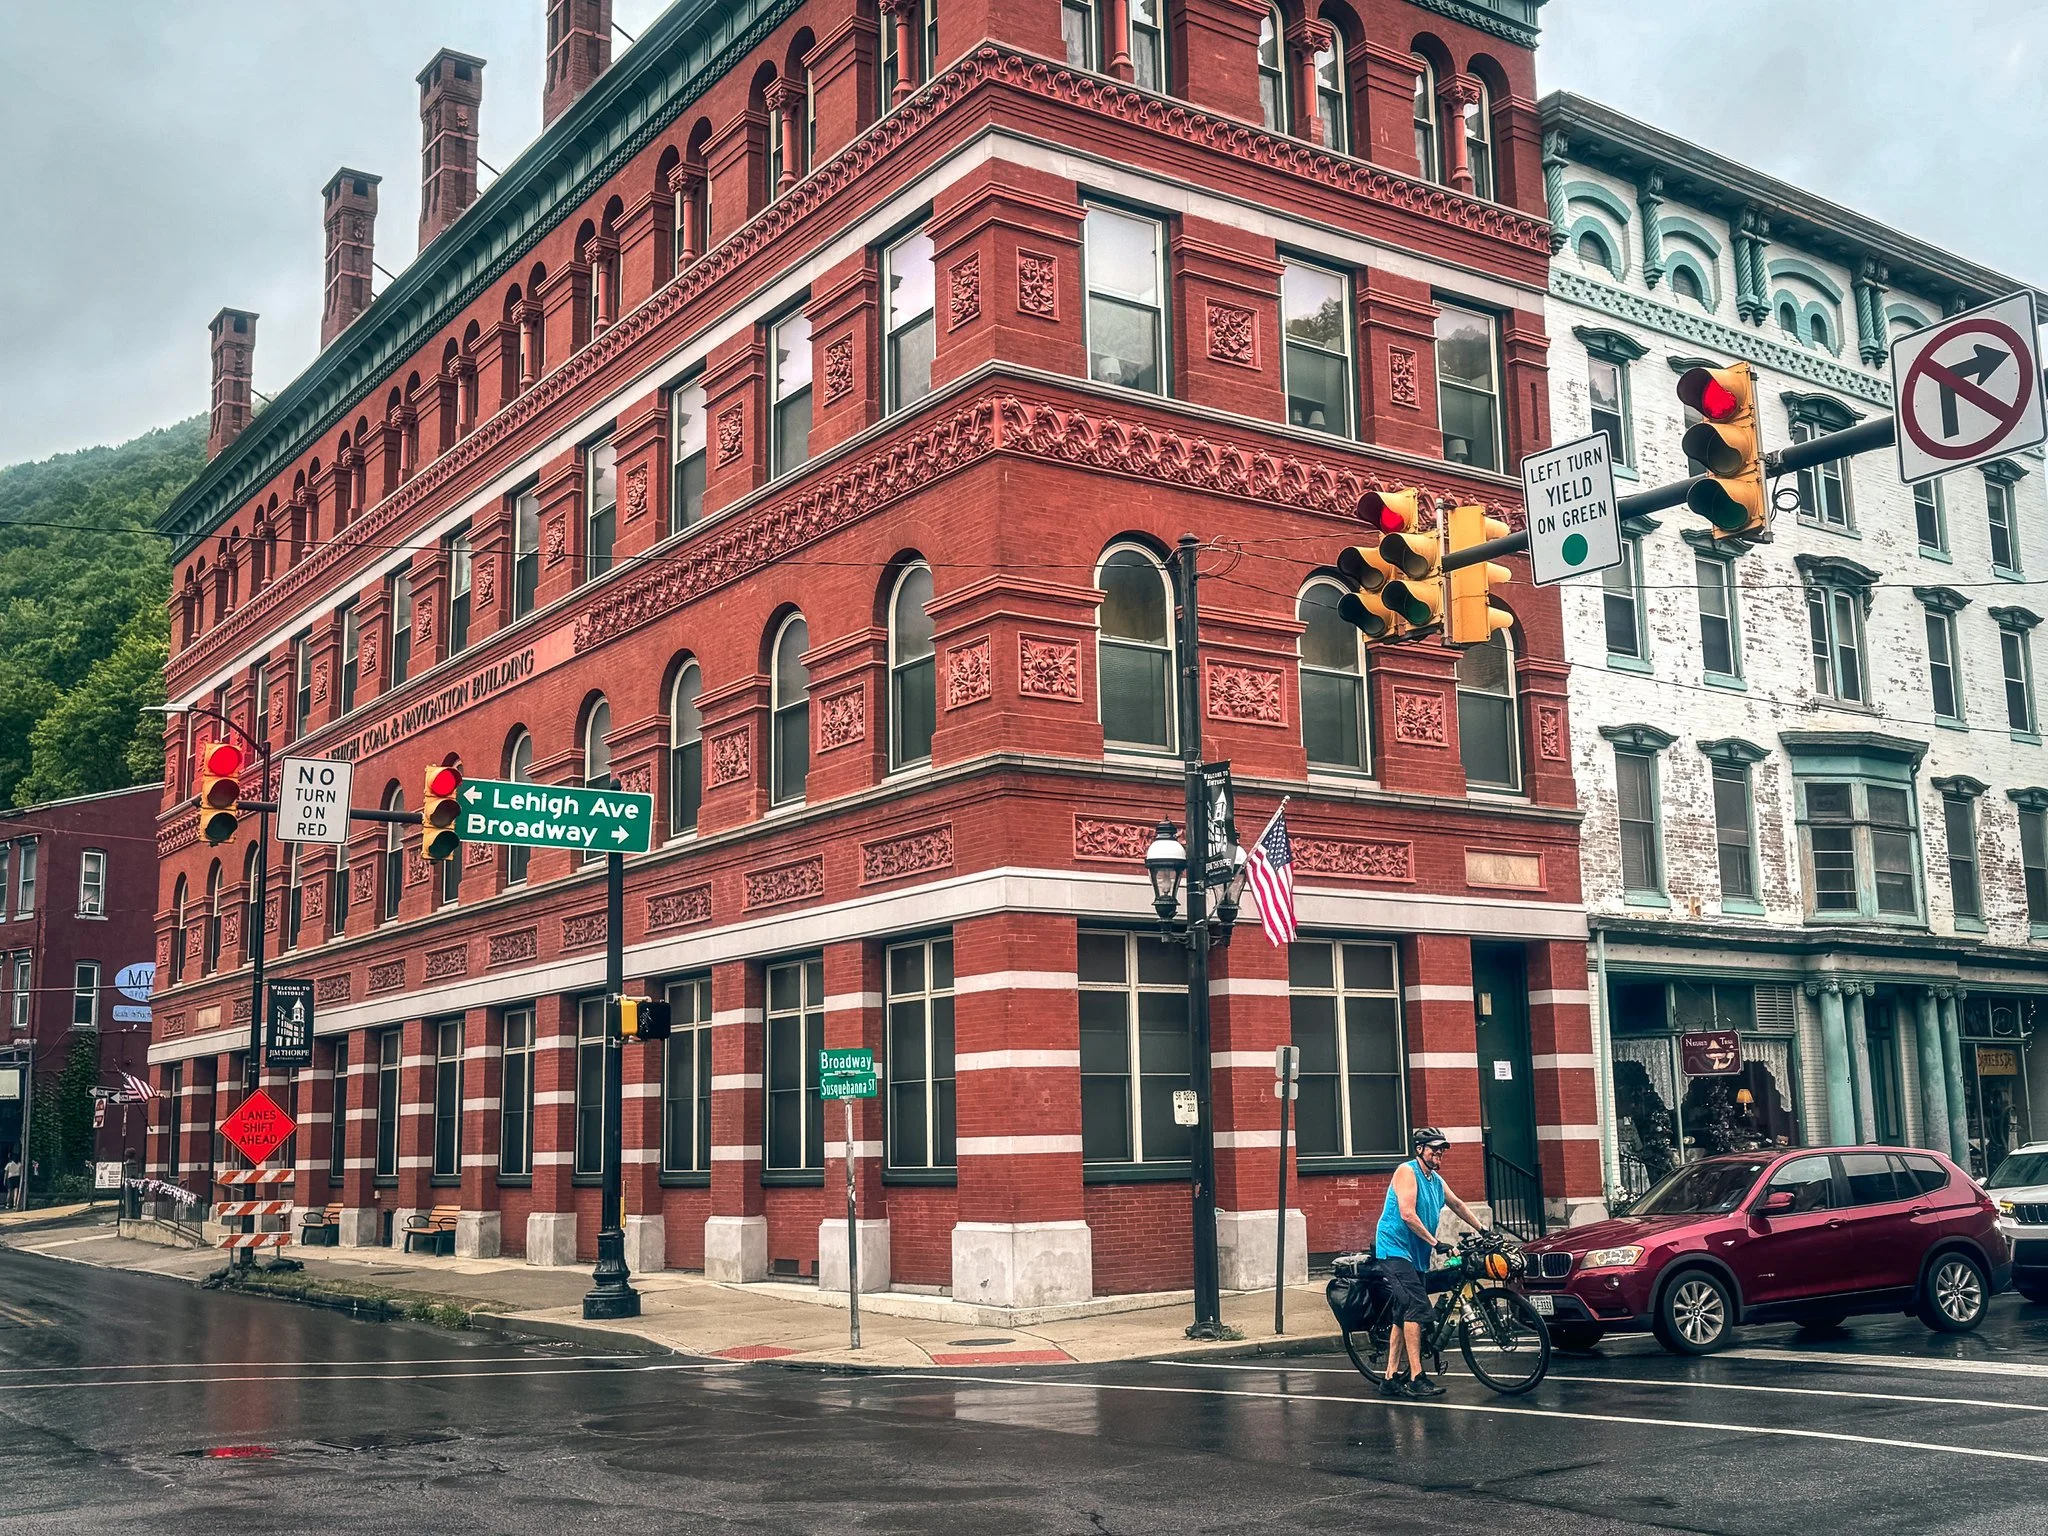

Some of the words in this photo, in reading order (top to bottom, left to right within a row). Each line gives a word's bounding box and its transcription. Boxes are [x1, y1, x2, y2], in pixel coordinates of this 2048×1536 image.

[1531, 460, 1561, 484] LEFT
[1567, 446, 1603, 472] TURN
[1546, 476, 1592, 507] YIELD
[1538, 515, 1555, 535] ON
[1562, 500, 1607, 528] GREEN
[363, 723, 389, 753] COAL
[391, 718, 399, 739] &
[401, 681, 469, 736] NAVIGATION
[472, 648, 534, 699] BUILDING
[299, 766, 335, 785] NO
[295, 788, 336, 803] TURN
[493, 788, 579, 820] Lehigh
[589, 797, 639, 820] Ave
[303, 805, 325, 819] ON
[297, 822, 327, 836] RED
[467, 813, 598, 847] Broadway
[269, 1049, 281, 1057] JIM
[821, 1051, 871, 1070] Broadway
[821, 1078, 867, 1096] Susquehanna
[241, 1110, 277, 1120] LANES
[243, 1122, 274, 1133] SHIFT
[240, 1134, 277, 1145] AHEAD
